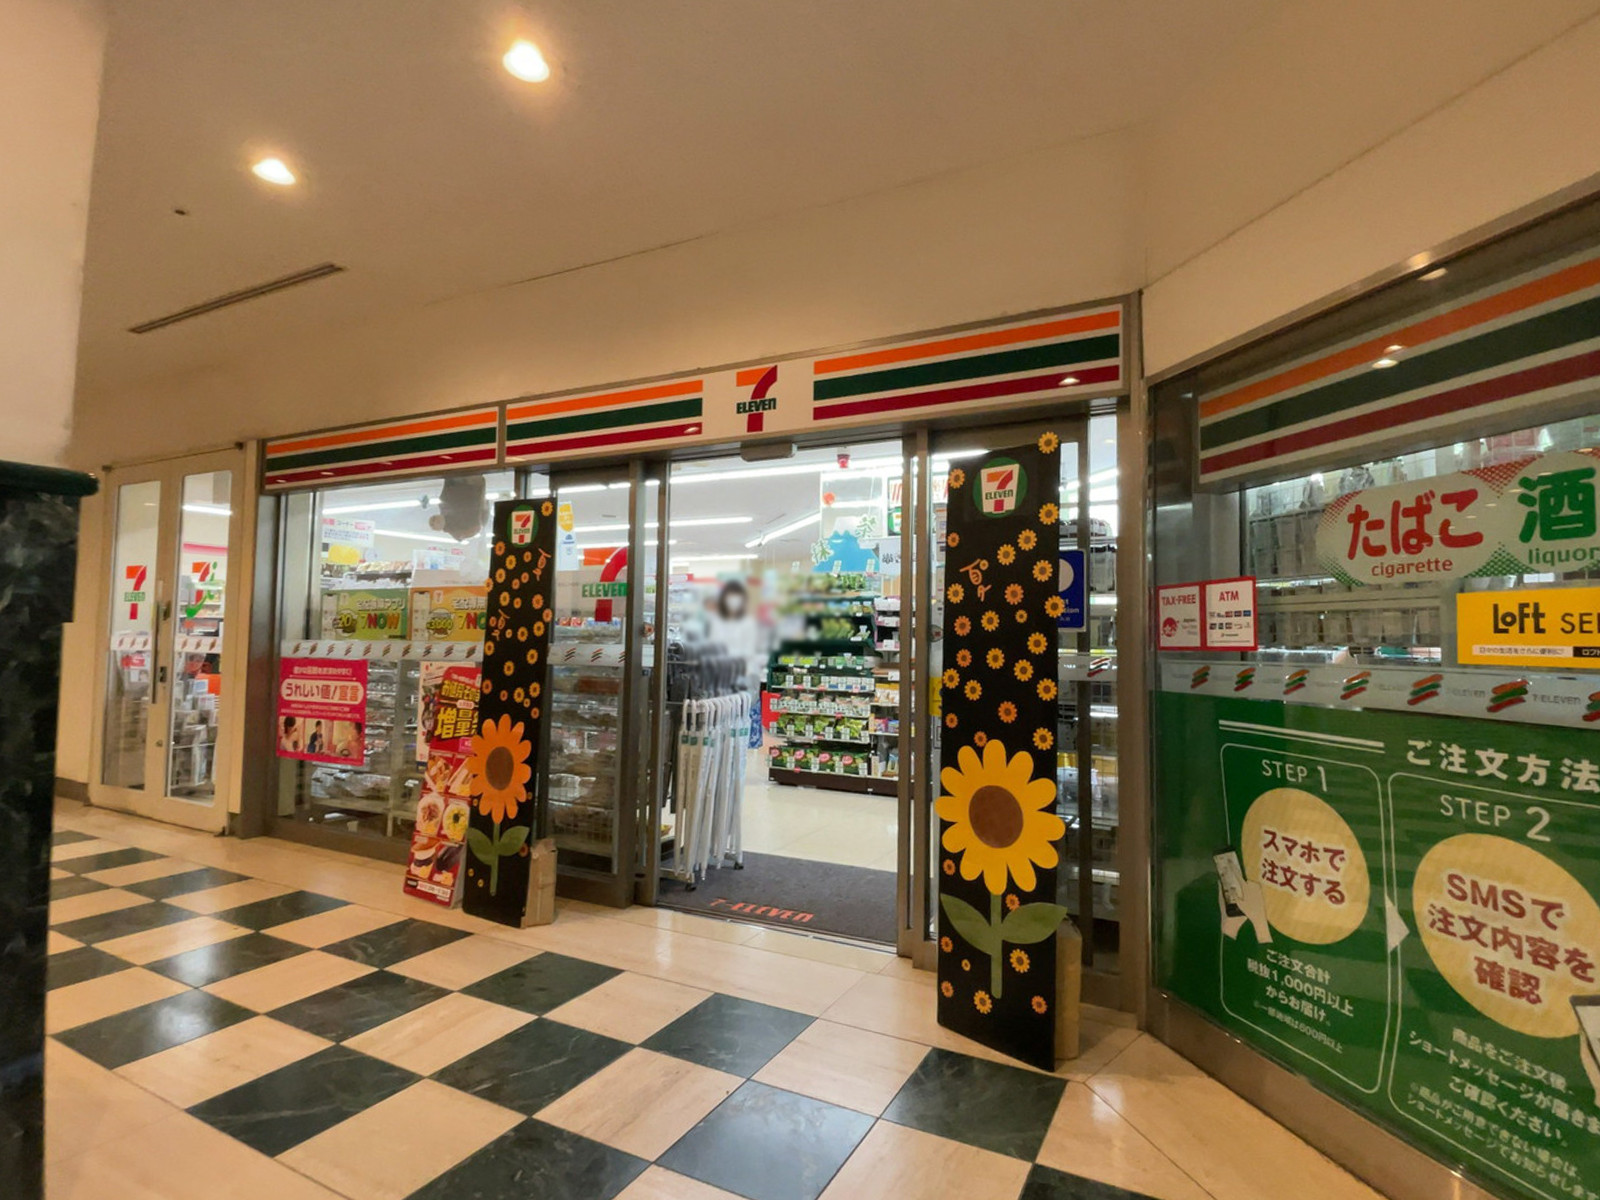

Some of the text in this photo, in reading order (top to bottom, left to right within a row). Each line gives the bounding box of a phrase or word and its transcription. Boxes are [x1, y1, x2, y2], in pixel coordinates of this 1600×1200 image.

[1347, 488, 1483, 560] たばこ
[1517, 466, 1597, 544] 酒
[1371, 556, 1454, 578] cigarette
[1528, 545, 1600, 567] liquor
[1161, 594, 1197, 606] TAX-FREE
[1218, 590, 1239, 602] ATM
[1560, 612, 1600, 634] SE
[434, 706, 479, 739] 増量
[1262, 759, 1328, 792] STEP 1
[1406, 739, 1600, 793] ご注文方法
[1440, 794, 1551, 842] STEP 2
[1263, 828, 1346, 873] スマホで
[1262, 858, 1345, 905] 注文する
[1447, 873, 1565, 931] SMSで
[1427, 903, 1595, 983] 注文内容を
[1266, 949, 1331, 985] ご注文合計
[1474, 956, 1542, 1005] 確認
